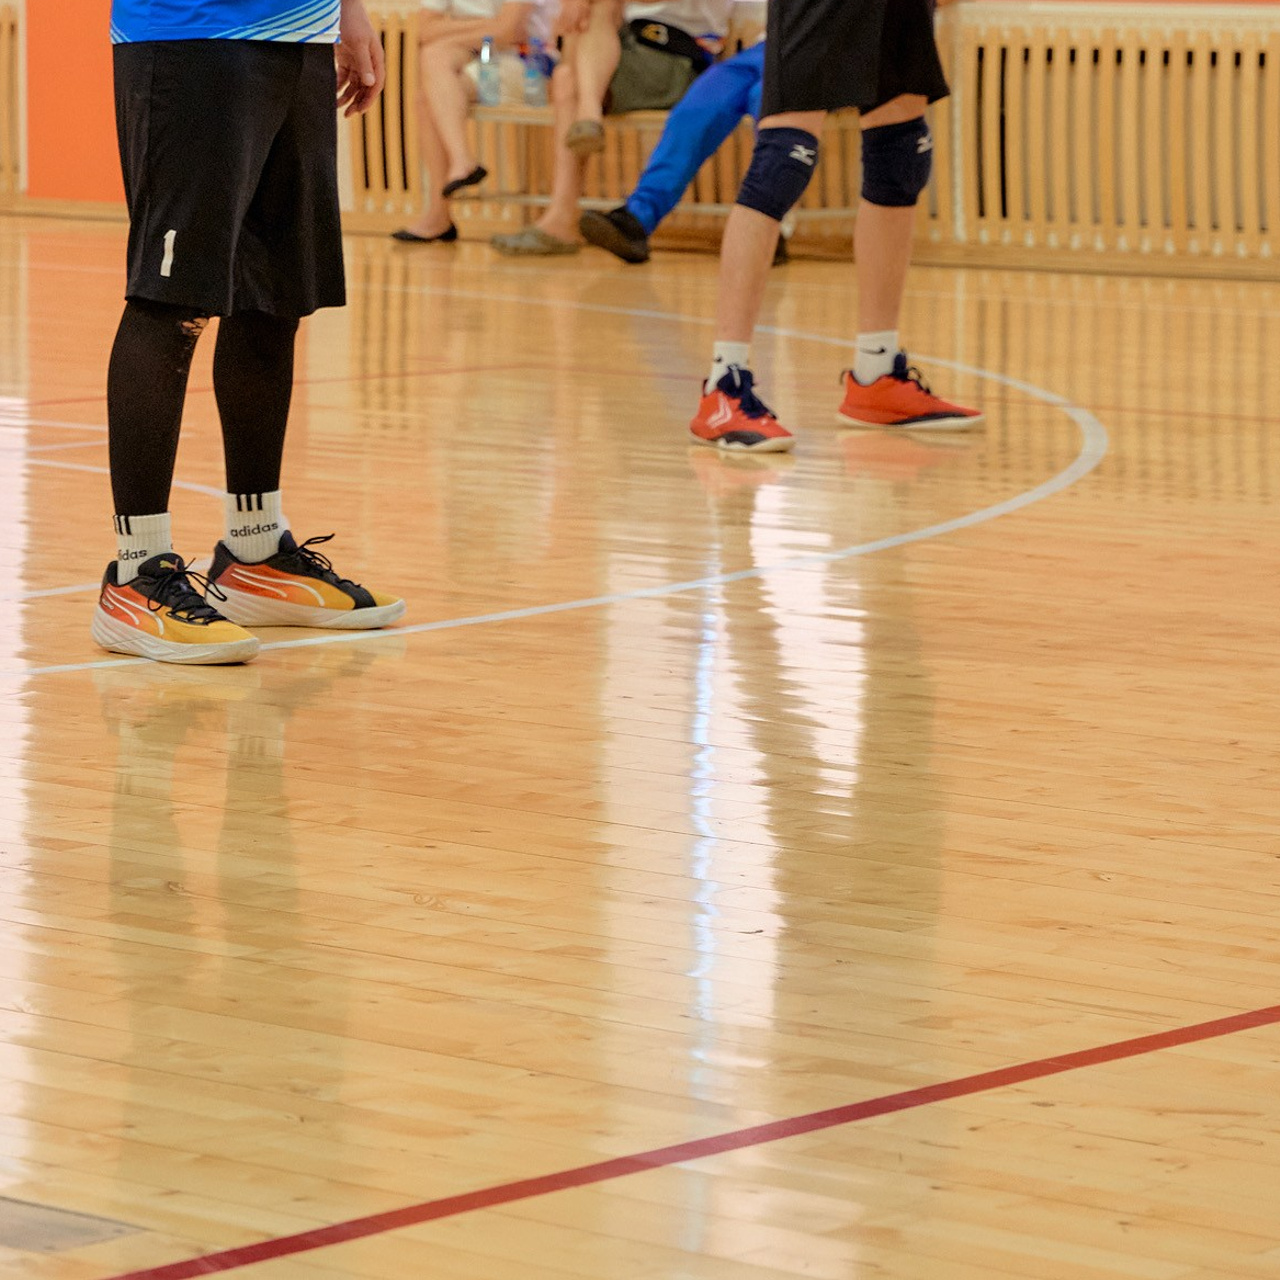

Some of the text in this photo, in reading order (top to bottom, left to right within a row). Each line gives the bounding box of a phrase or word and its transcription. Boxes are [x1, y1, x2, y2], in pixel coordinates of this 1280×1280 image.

[160, 229, 177, 277] 1
[230, 523, 278, 537] adidas
[117, 549, 147, 561] idas
